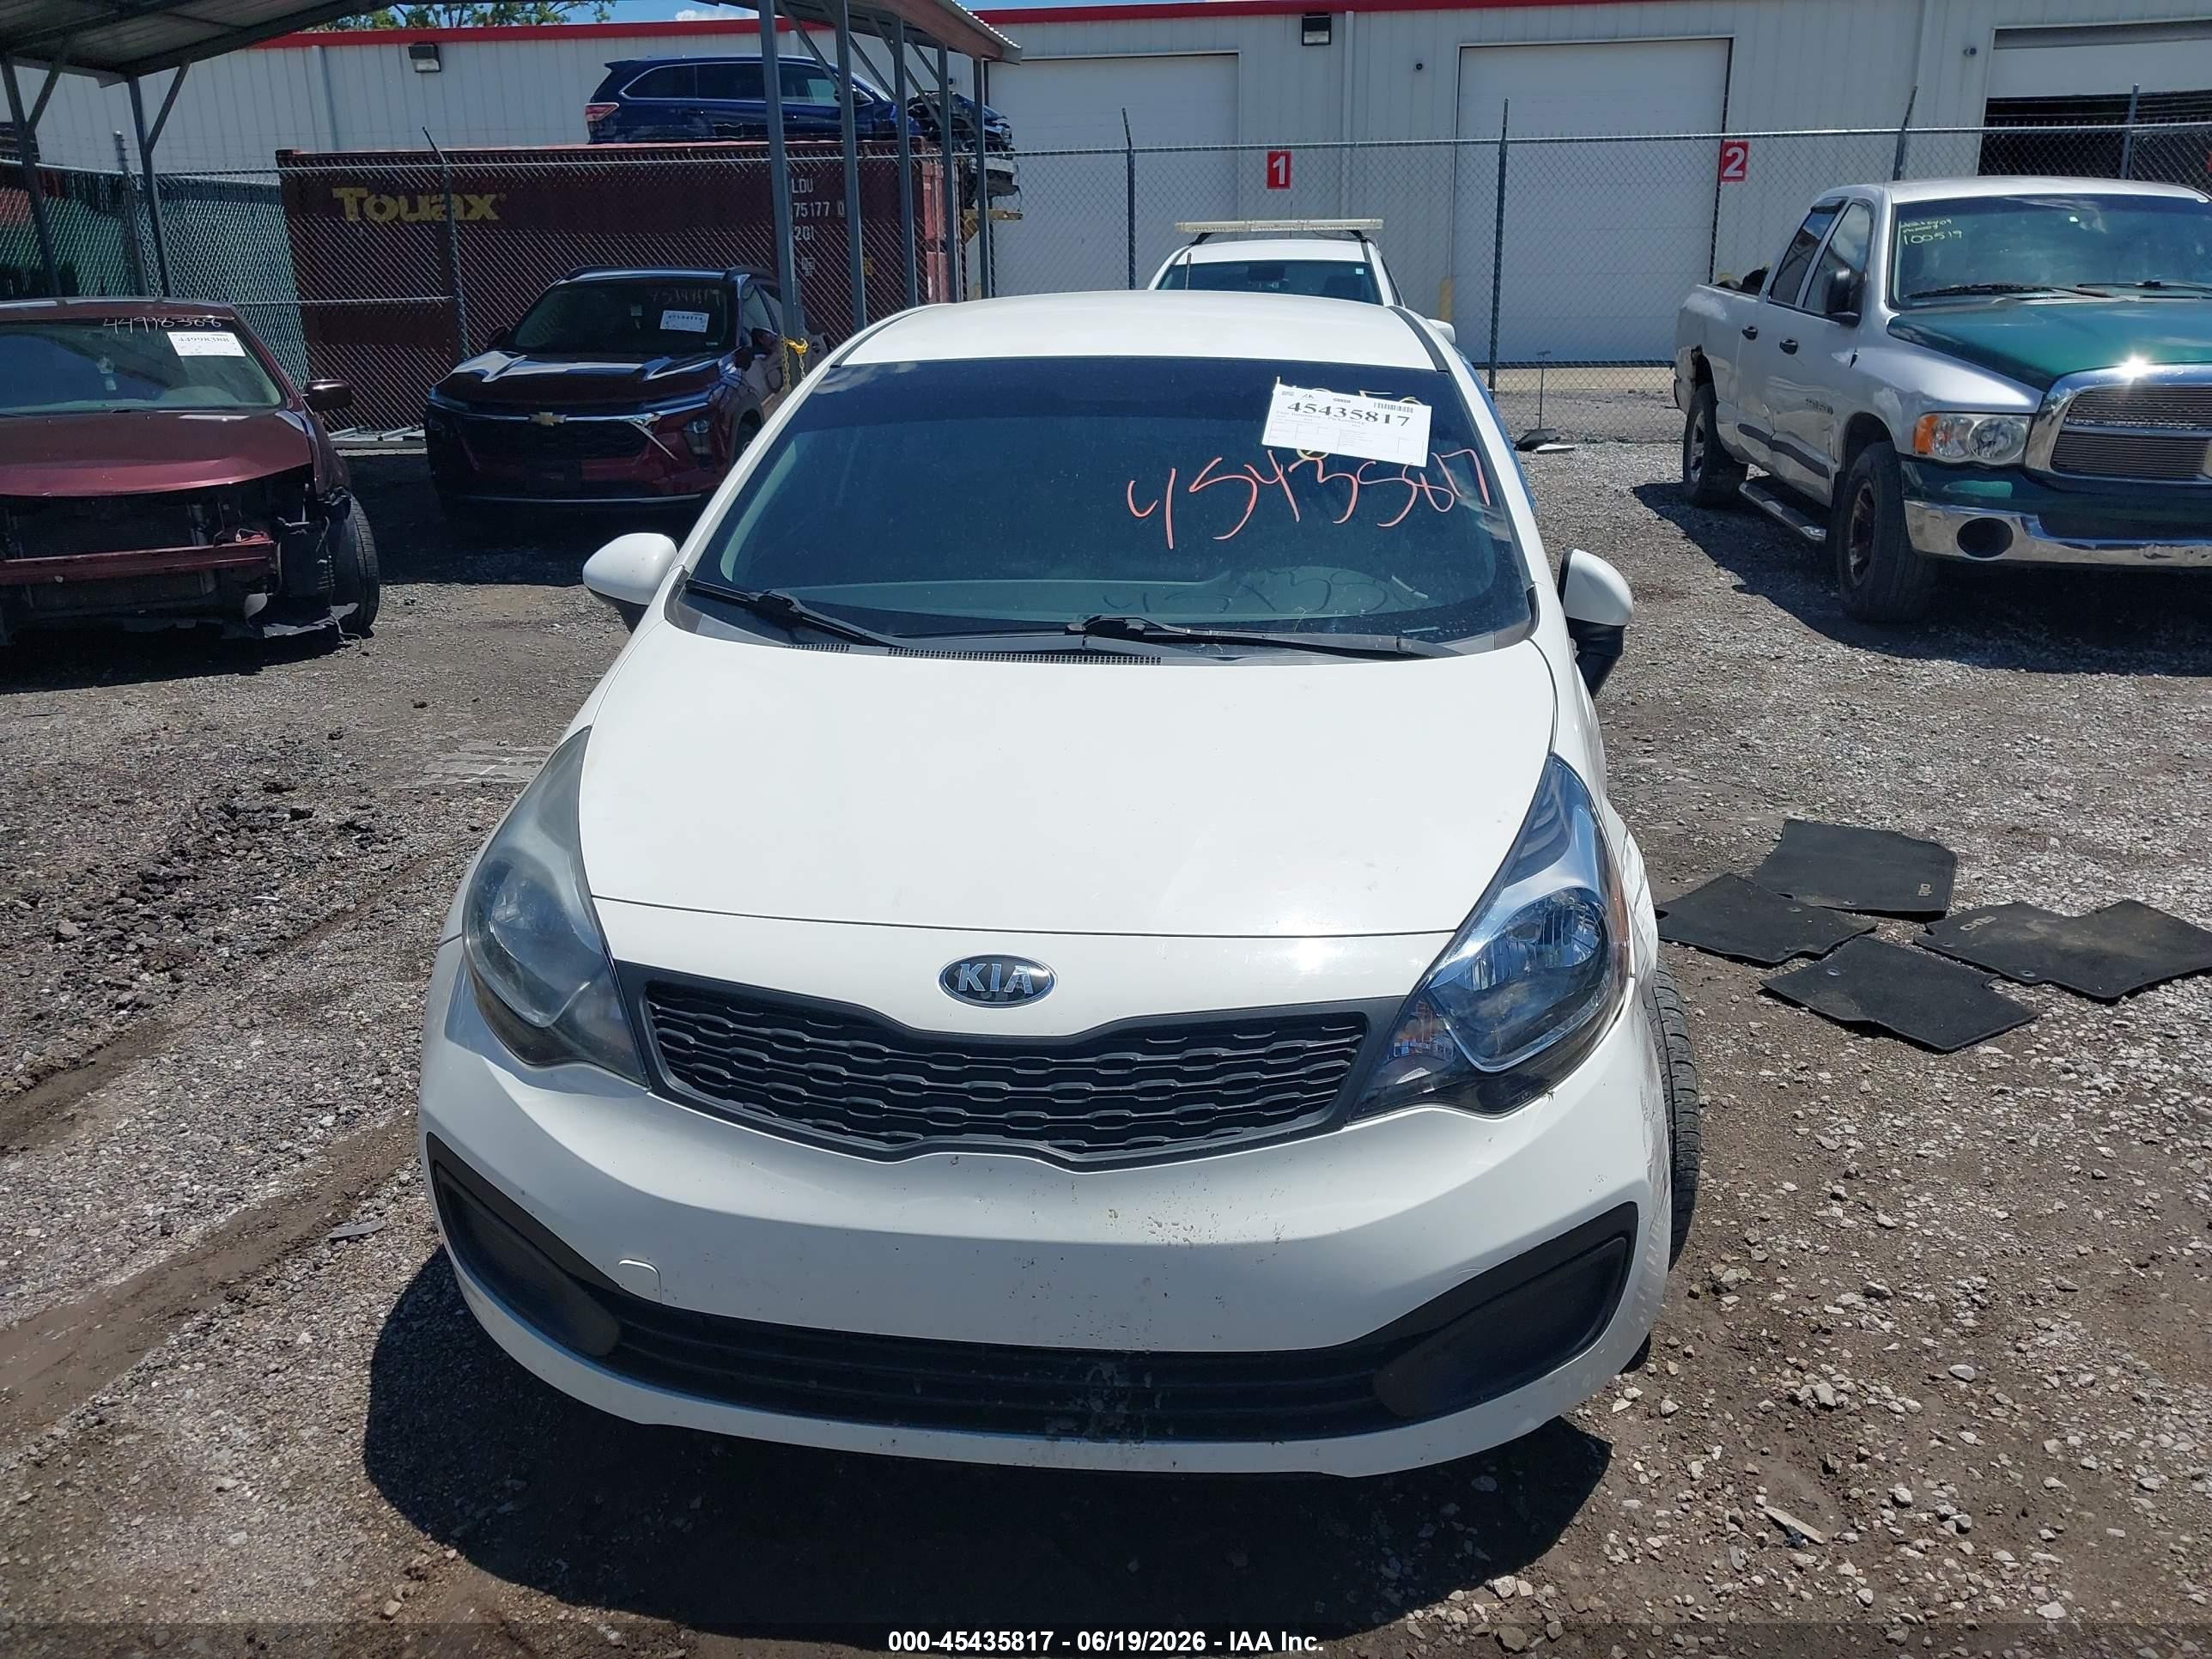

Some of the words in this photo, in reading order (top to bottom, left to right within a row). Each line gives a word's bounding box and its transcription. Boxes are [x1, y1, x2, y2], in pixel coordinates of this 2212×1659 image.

[1272, 155, 1286, 185] 1
[1723, 146, 1746, 178] 2
[1287, 402, 1411, 427] 45435817
[957, 963, 1034, 994] KIA
